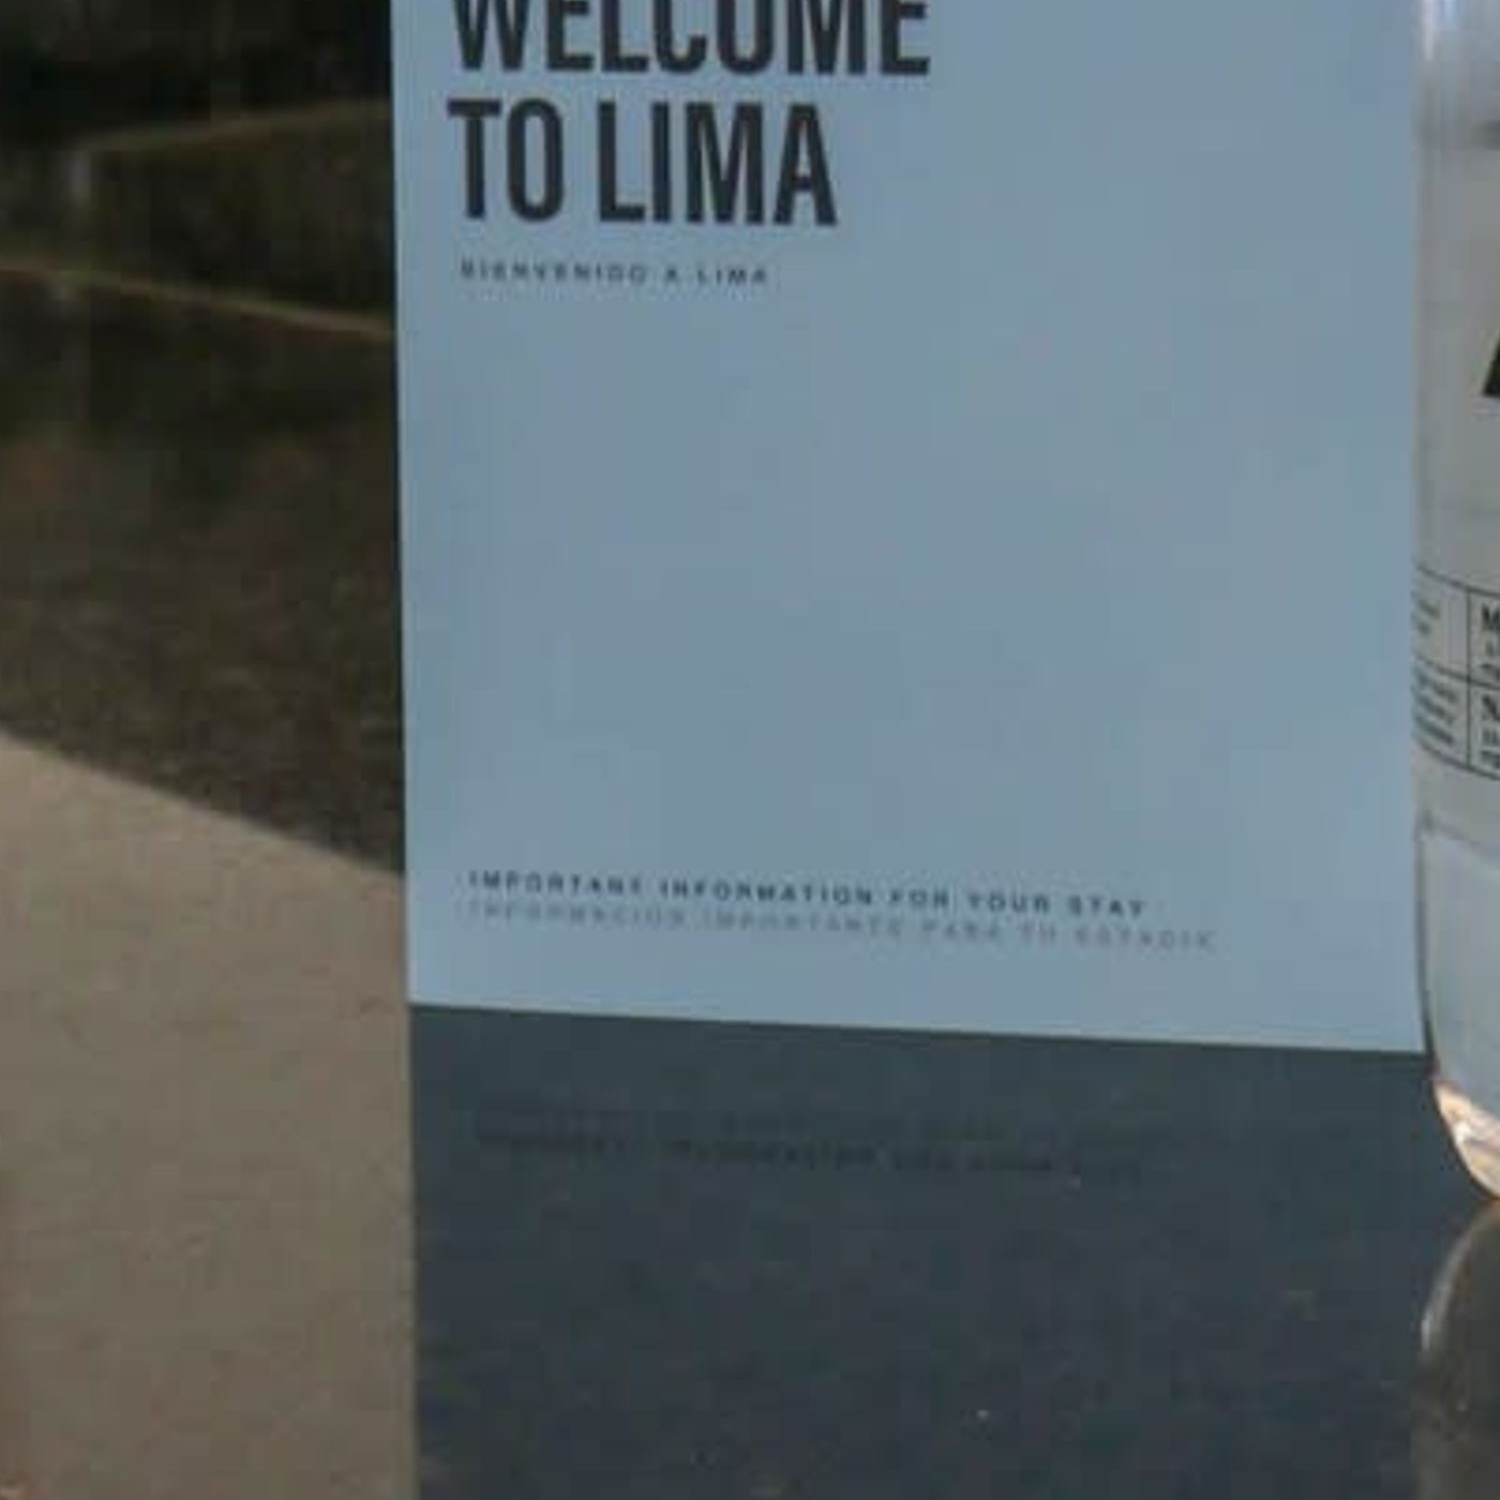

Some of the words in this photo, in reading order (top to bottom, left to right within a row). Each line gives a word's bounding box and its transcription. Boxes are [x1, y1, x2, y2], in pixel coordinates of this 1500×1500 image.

[448, 97, 565, 223] TO
[595, 101, 838, 226] LIMA
[461, 259, 647, 284] BIENVENIDO
[664, 266, 681, 282] A
[697, 266, 768, 287] LIMA
[468, 869, 642, 897] IMPORTANT
[659, 876, 873, 906] INFORMATION
[889, 887, 950, 911] FOR
[969, 888, 1050, 915] YOUR
[1068, 894, 1144, 920] STAY
